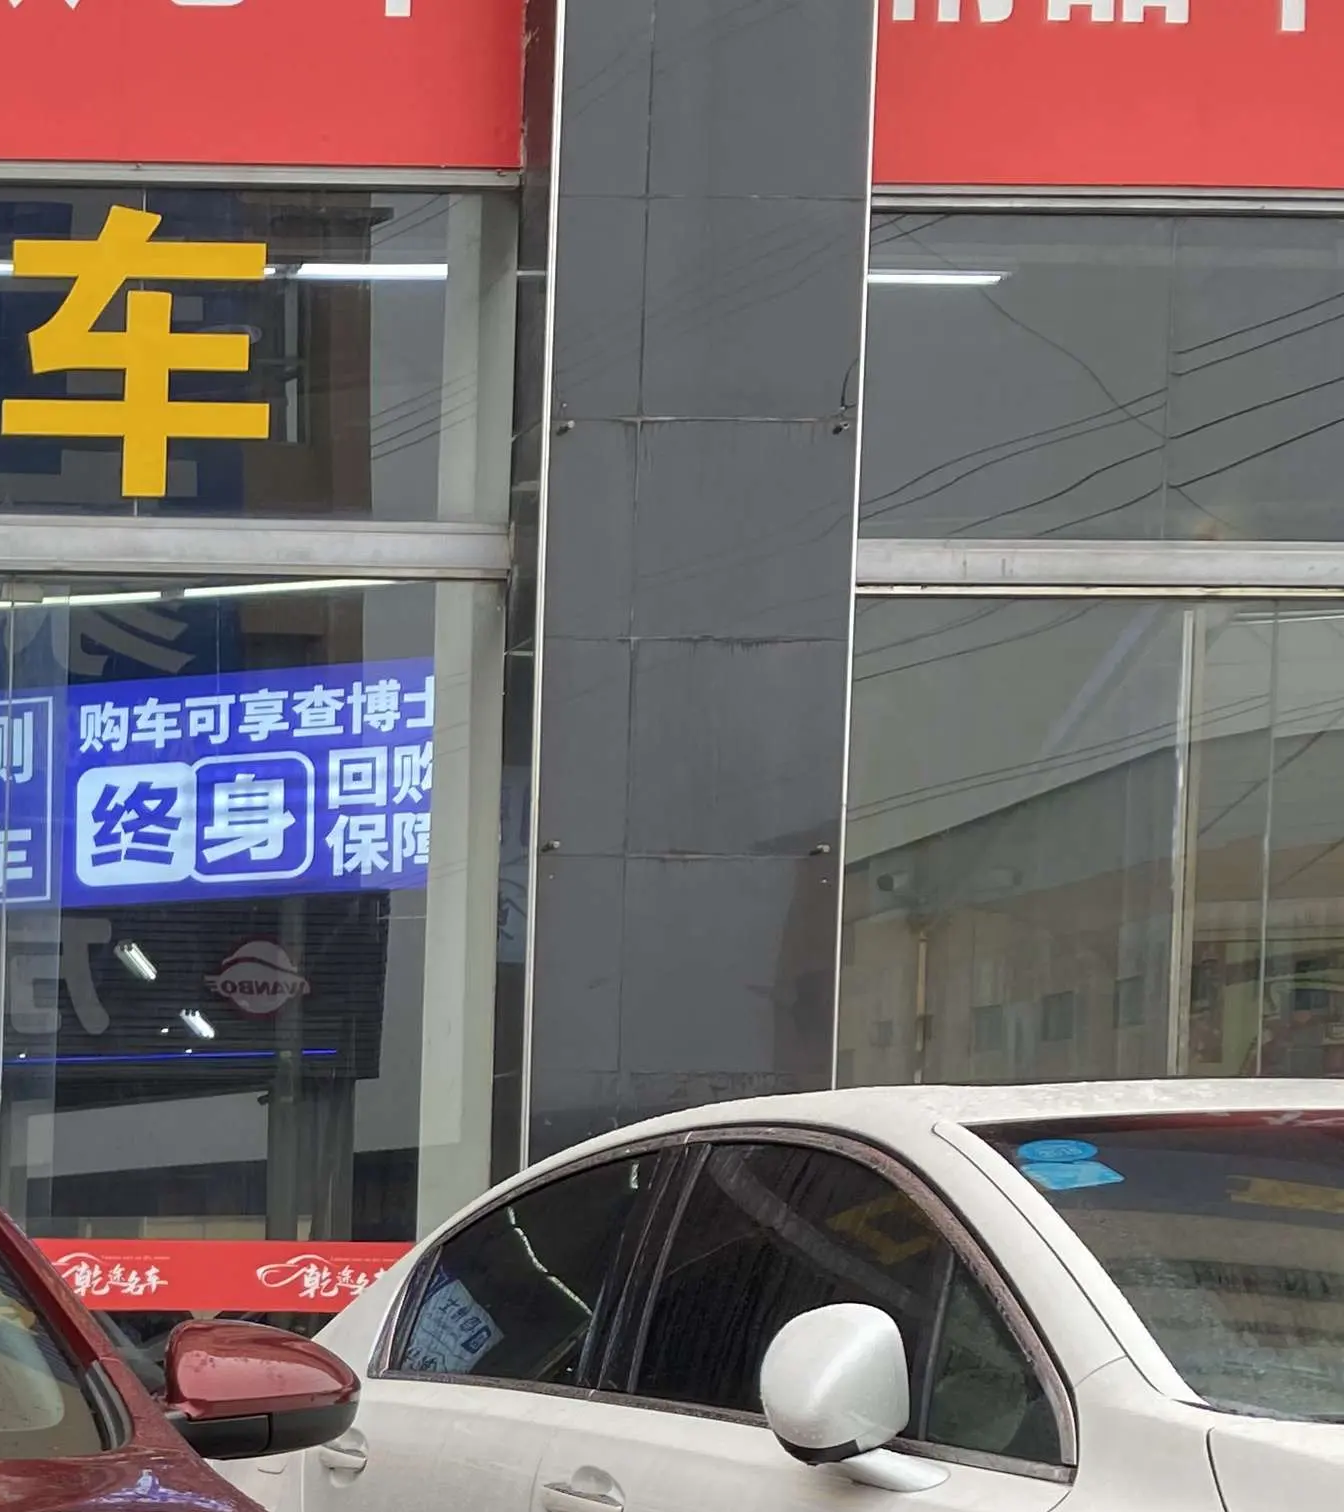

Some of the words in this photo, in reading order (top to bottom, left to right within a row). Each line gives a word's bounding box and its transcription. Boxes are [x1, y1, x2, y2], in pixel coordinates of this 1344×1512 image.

[79, 675, 435, 753] 购车可享查博士
[90, 773, 295, 867] 终身
